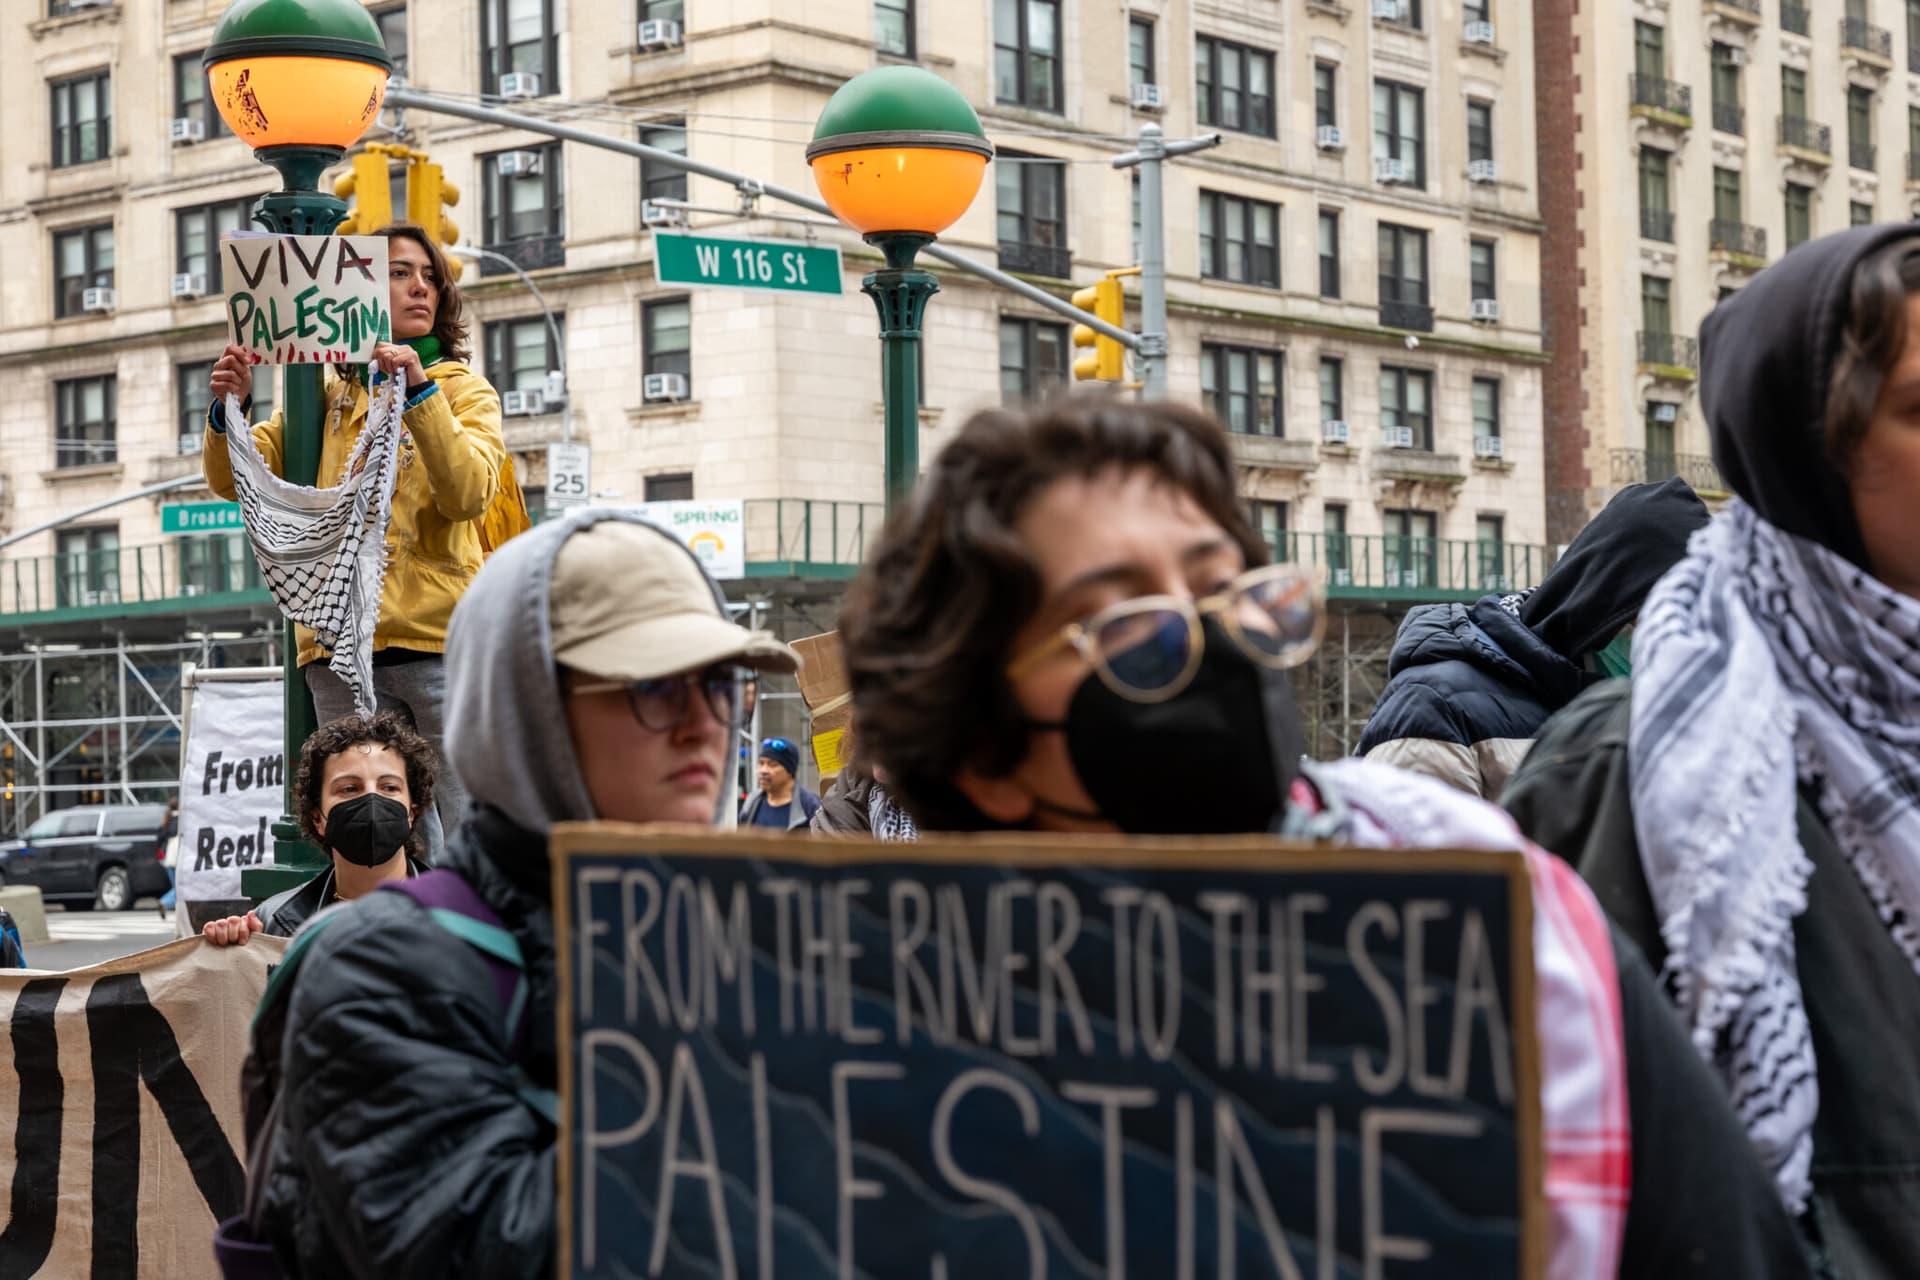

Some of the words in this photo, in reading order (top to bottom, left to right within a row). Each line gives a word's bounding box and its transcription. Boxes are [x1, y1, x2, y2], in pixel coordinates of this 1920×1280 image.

[229, 237, 376, 290] VIVA
[696, 245, 719, 277] W
[732, 248, 773, 282] 116
[782, 252, 808, 285] St
[554, 473, 585, 494] 25
[178, 509, 244, 527] Broadw
[202, 751, 284, 796] From
[194, 816, 267, 872] Real
[577, 866, 756, 1036] FROM
[759, 878, 886, 1045] THE
[889, 878, 1095, 1056] RIVER
[1101, 886, 1182, 1062] TO
[1196, 891, 1338, 1083] THE
[1345, 899, 1518, 1104] SEA
